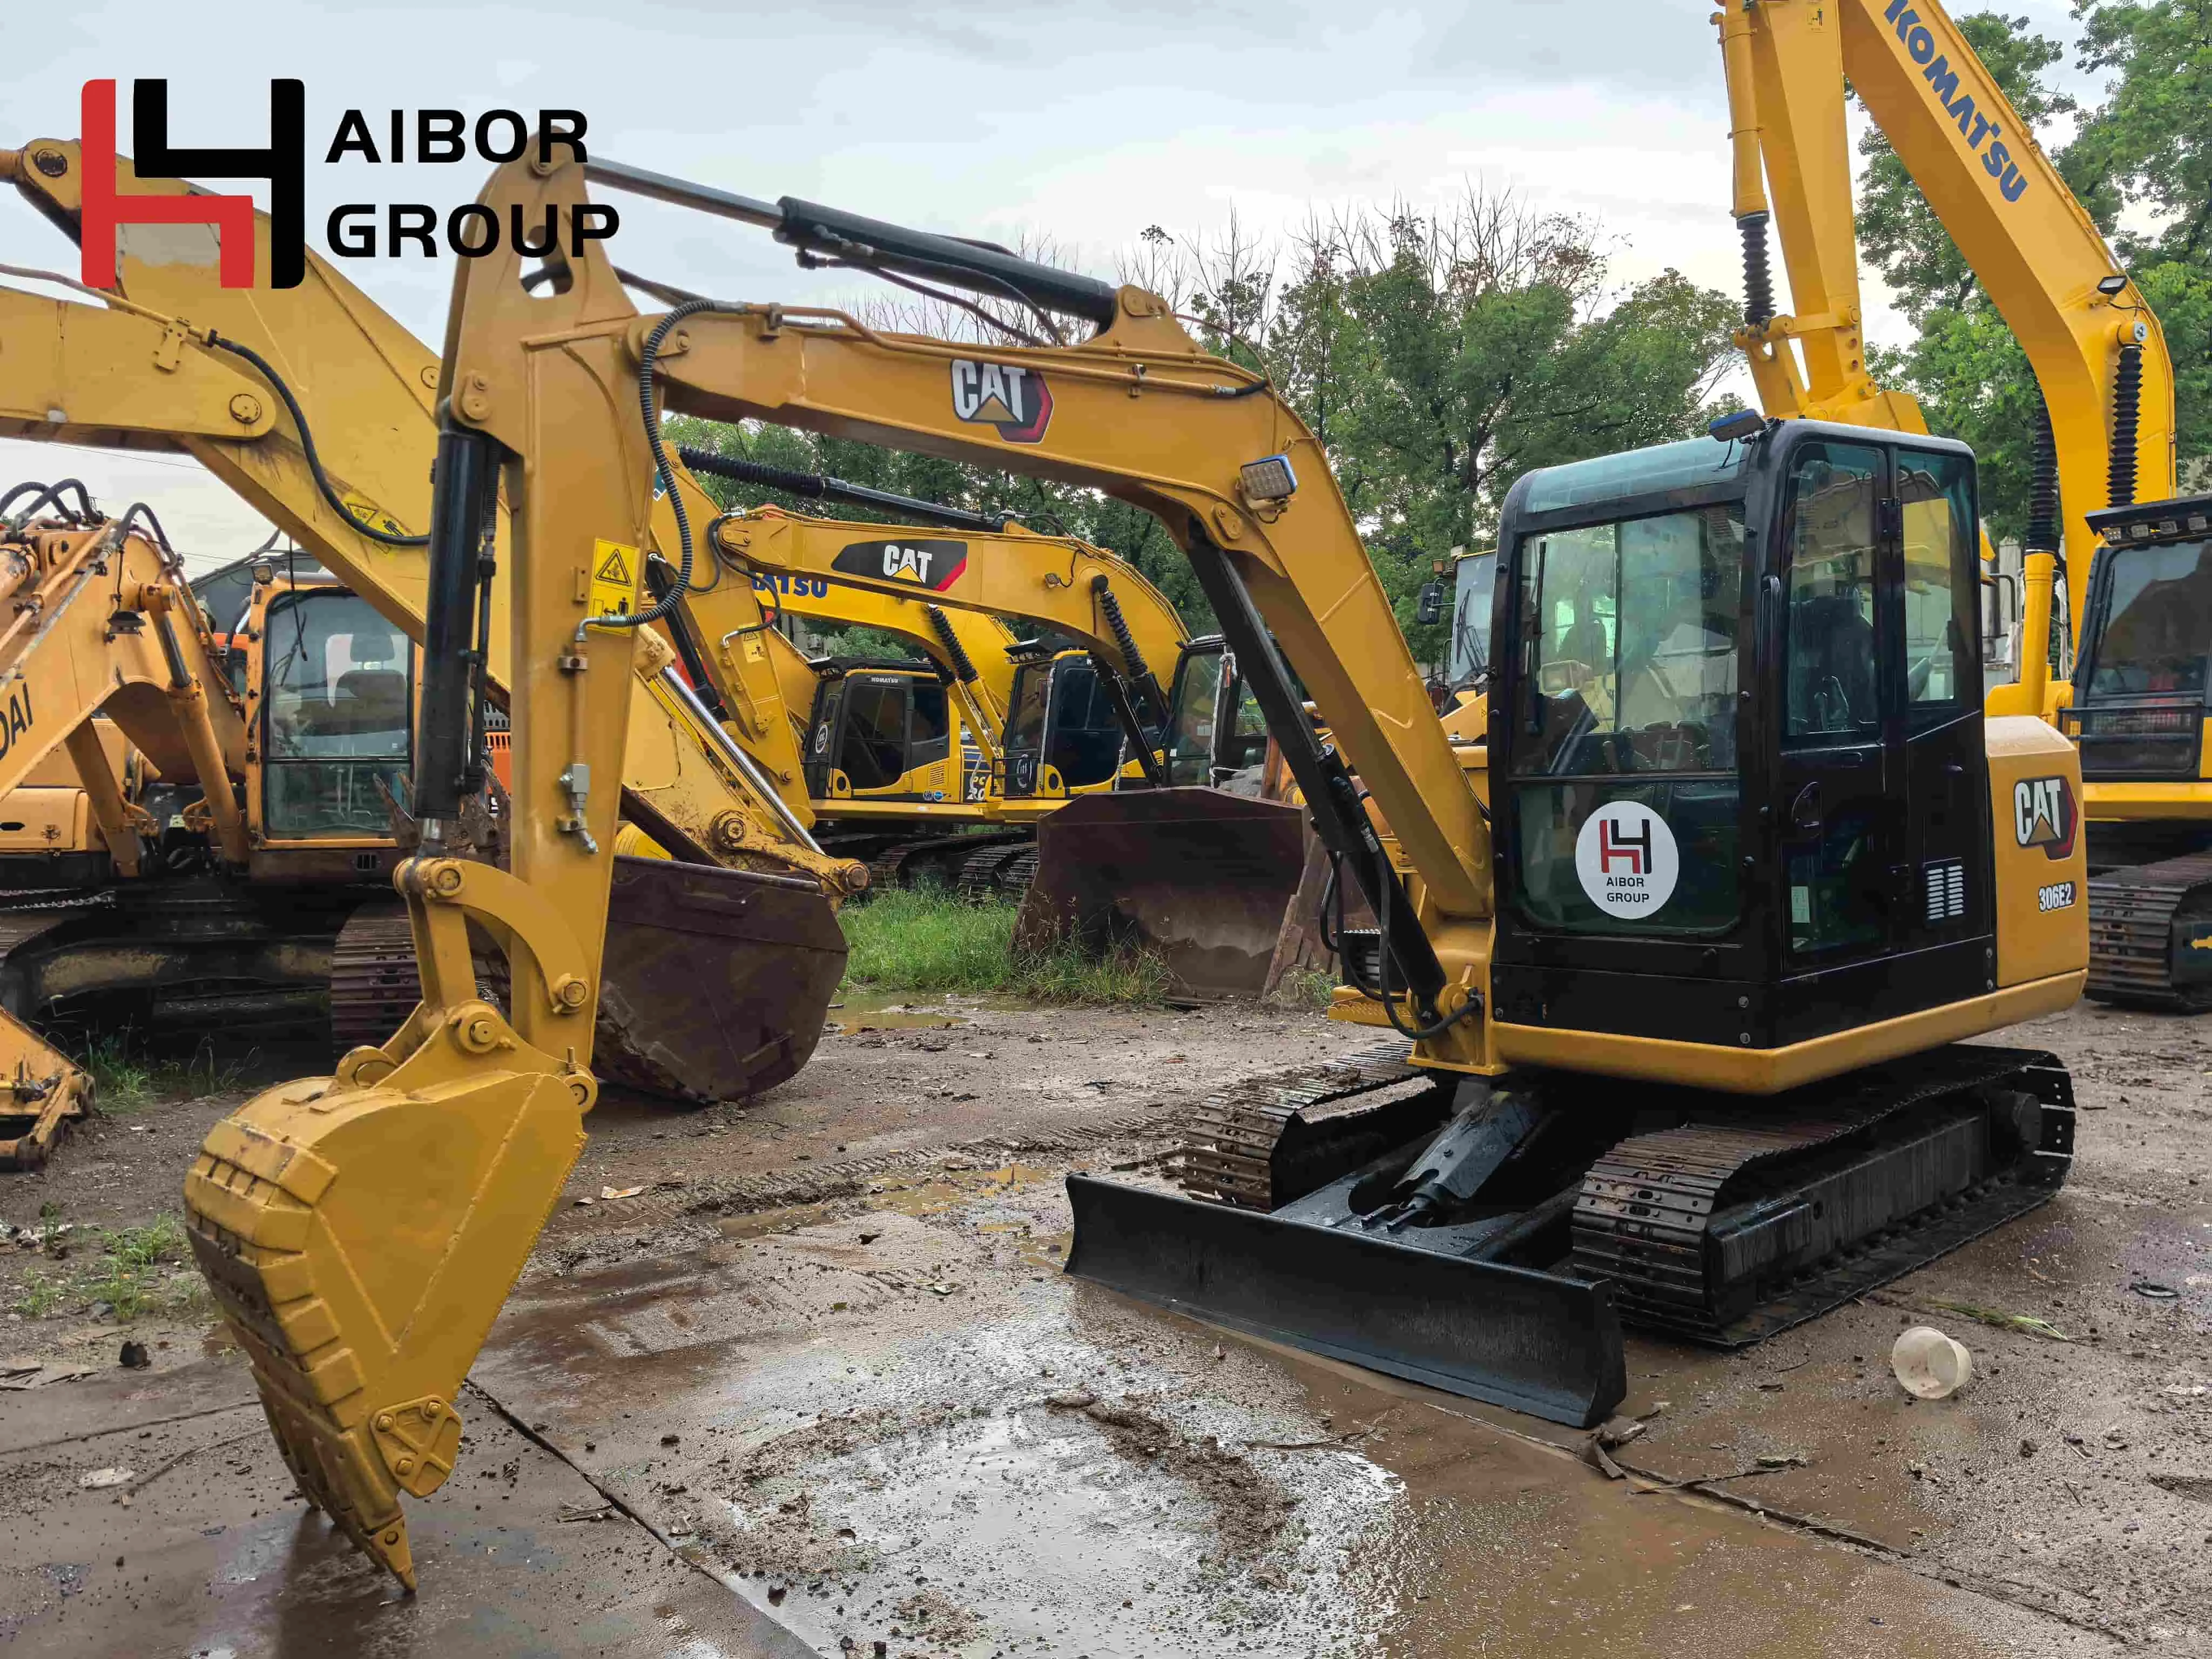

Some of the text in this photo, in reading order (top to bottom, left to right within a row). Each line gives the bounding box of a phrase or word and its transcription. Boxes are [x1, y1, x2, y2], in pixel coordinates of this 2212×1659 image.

[1884, 0, 2028, 203] KOMATSU
[952, 359, 1027, 422] CAT
[883, 544, 933, 584] CAT
[752, 575, 828, 598] ATSU
[2015, 779, 2061, 845] CAT
[1607, 876, 1644, 887] AIBOR
[1607, 892, 1650, 903] GROUP
[2039, 882, 2073, 912] 306E2
